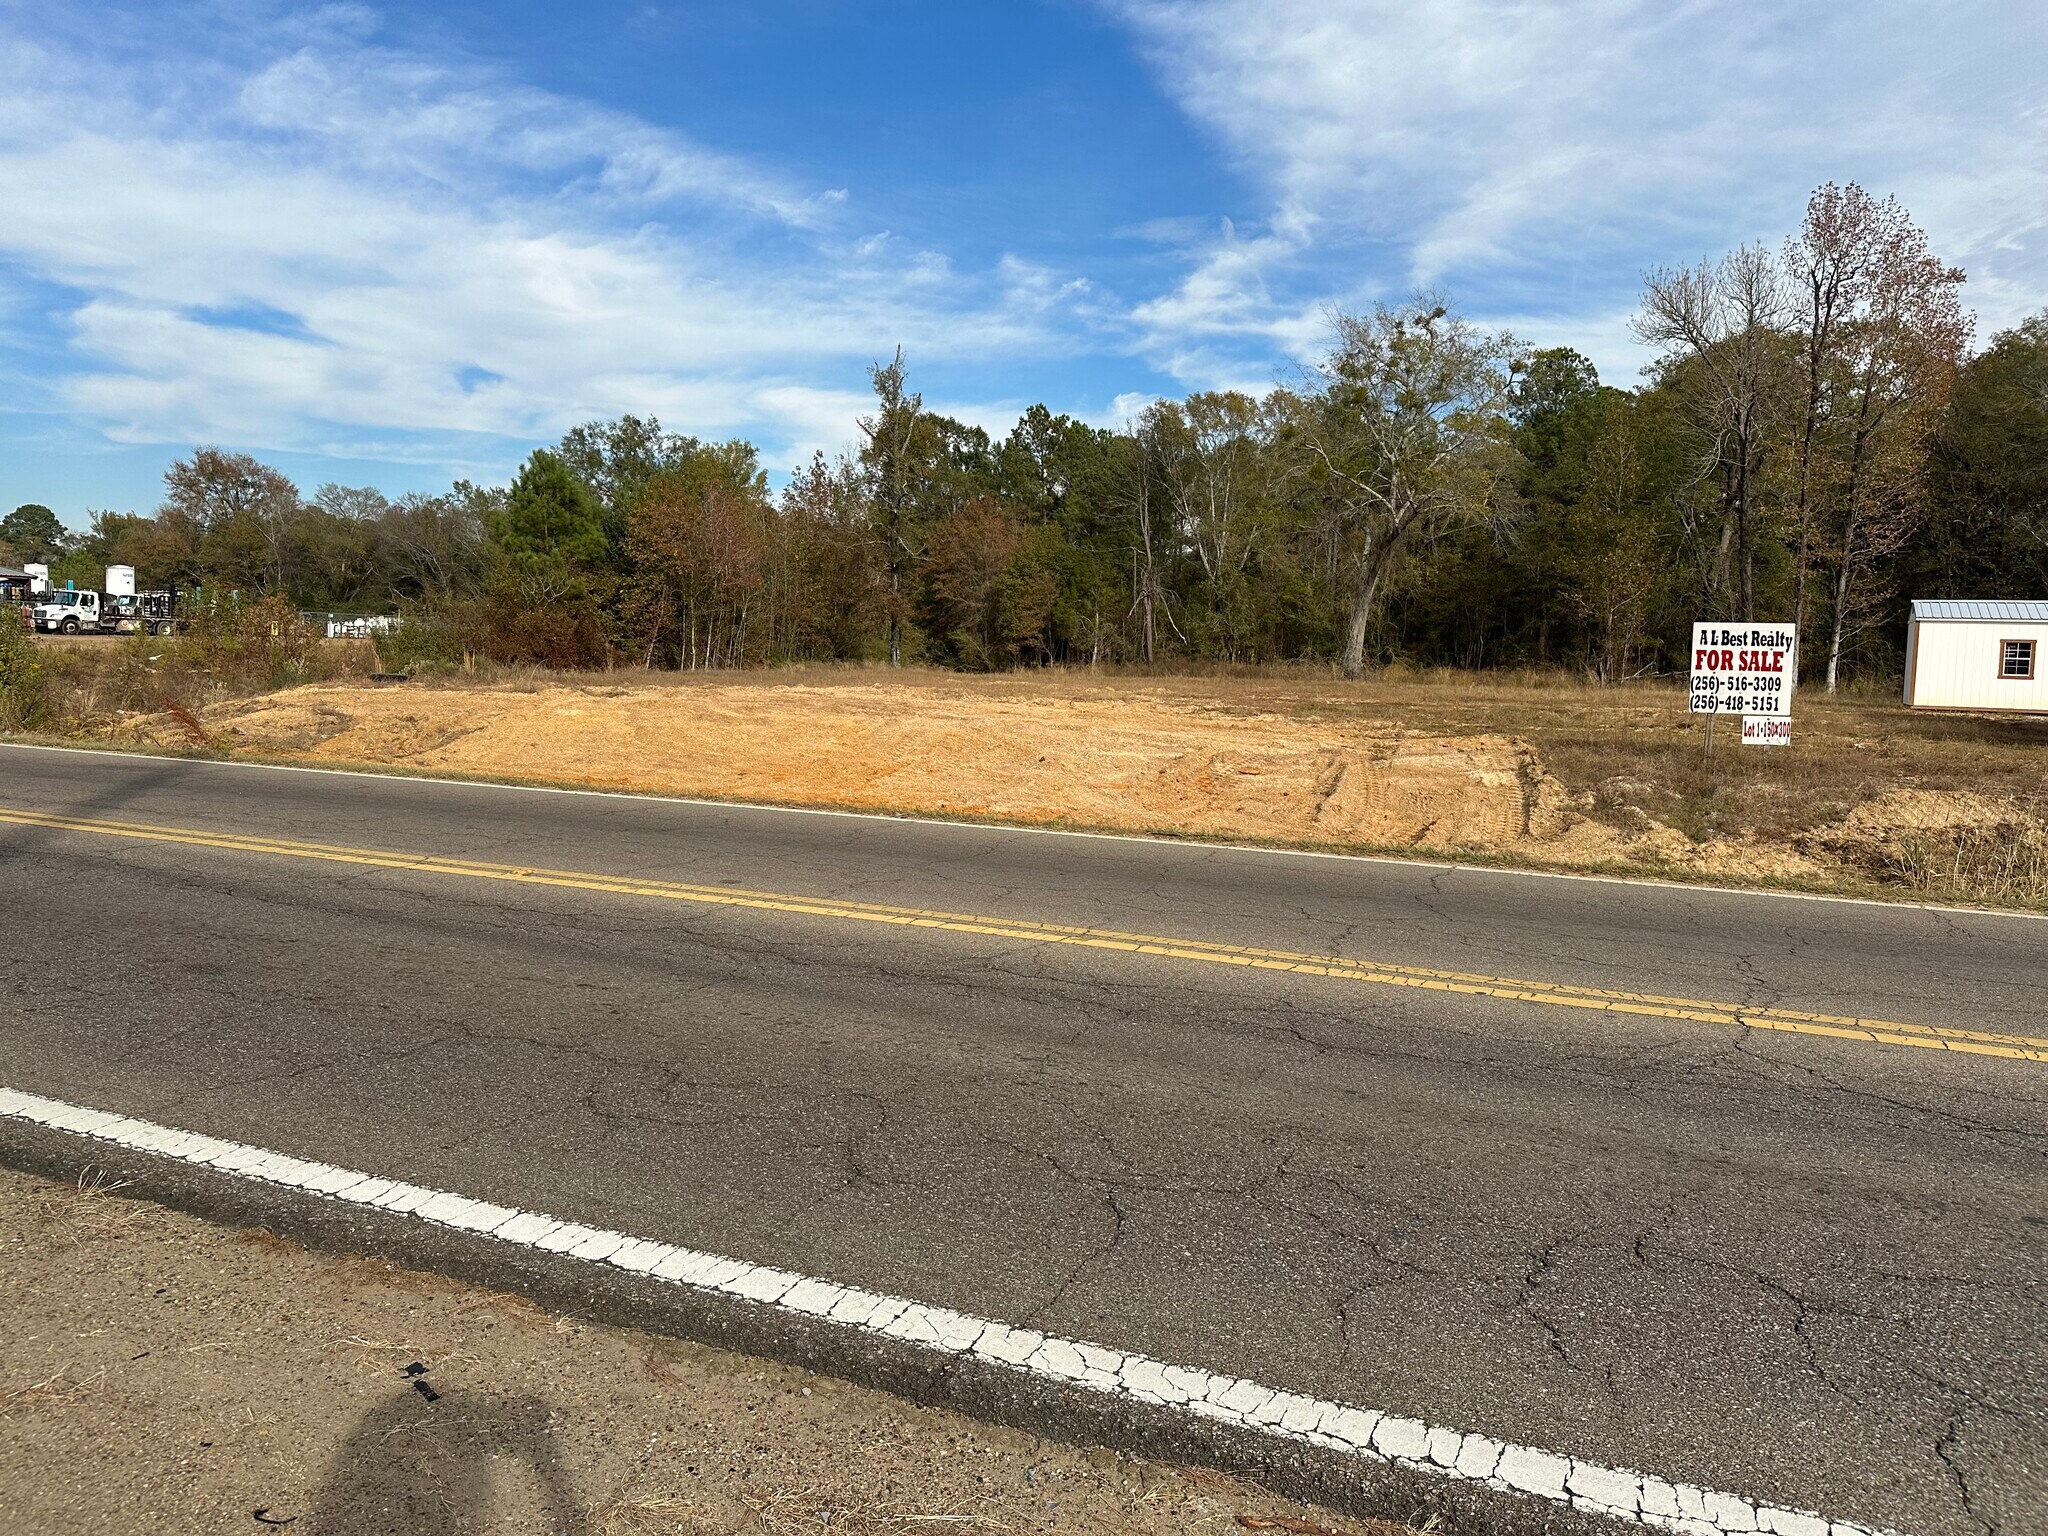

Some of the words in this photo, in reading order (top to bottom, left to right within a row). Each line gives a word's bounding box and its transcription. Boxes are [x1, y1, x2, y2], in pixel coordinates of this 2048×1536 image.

[1700, 630, 1708, 645] A
[1721, 630, 1748, 647] Best
[1751, 630, 1793, 653] Realty
[1695, 649, 1734, 671] FOR
[1738, 650, 1784, 672] SALE
[1744, 721, 1755, 737] Lot
